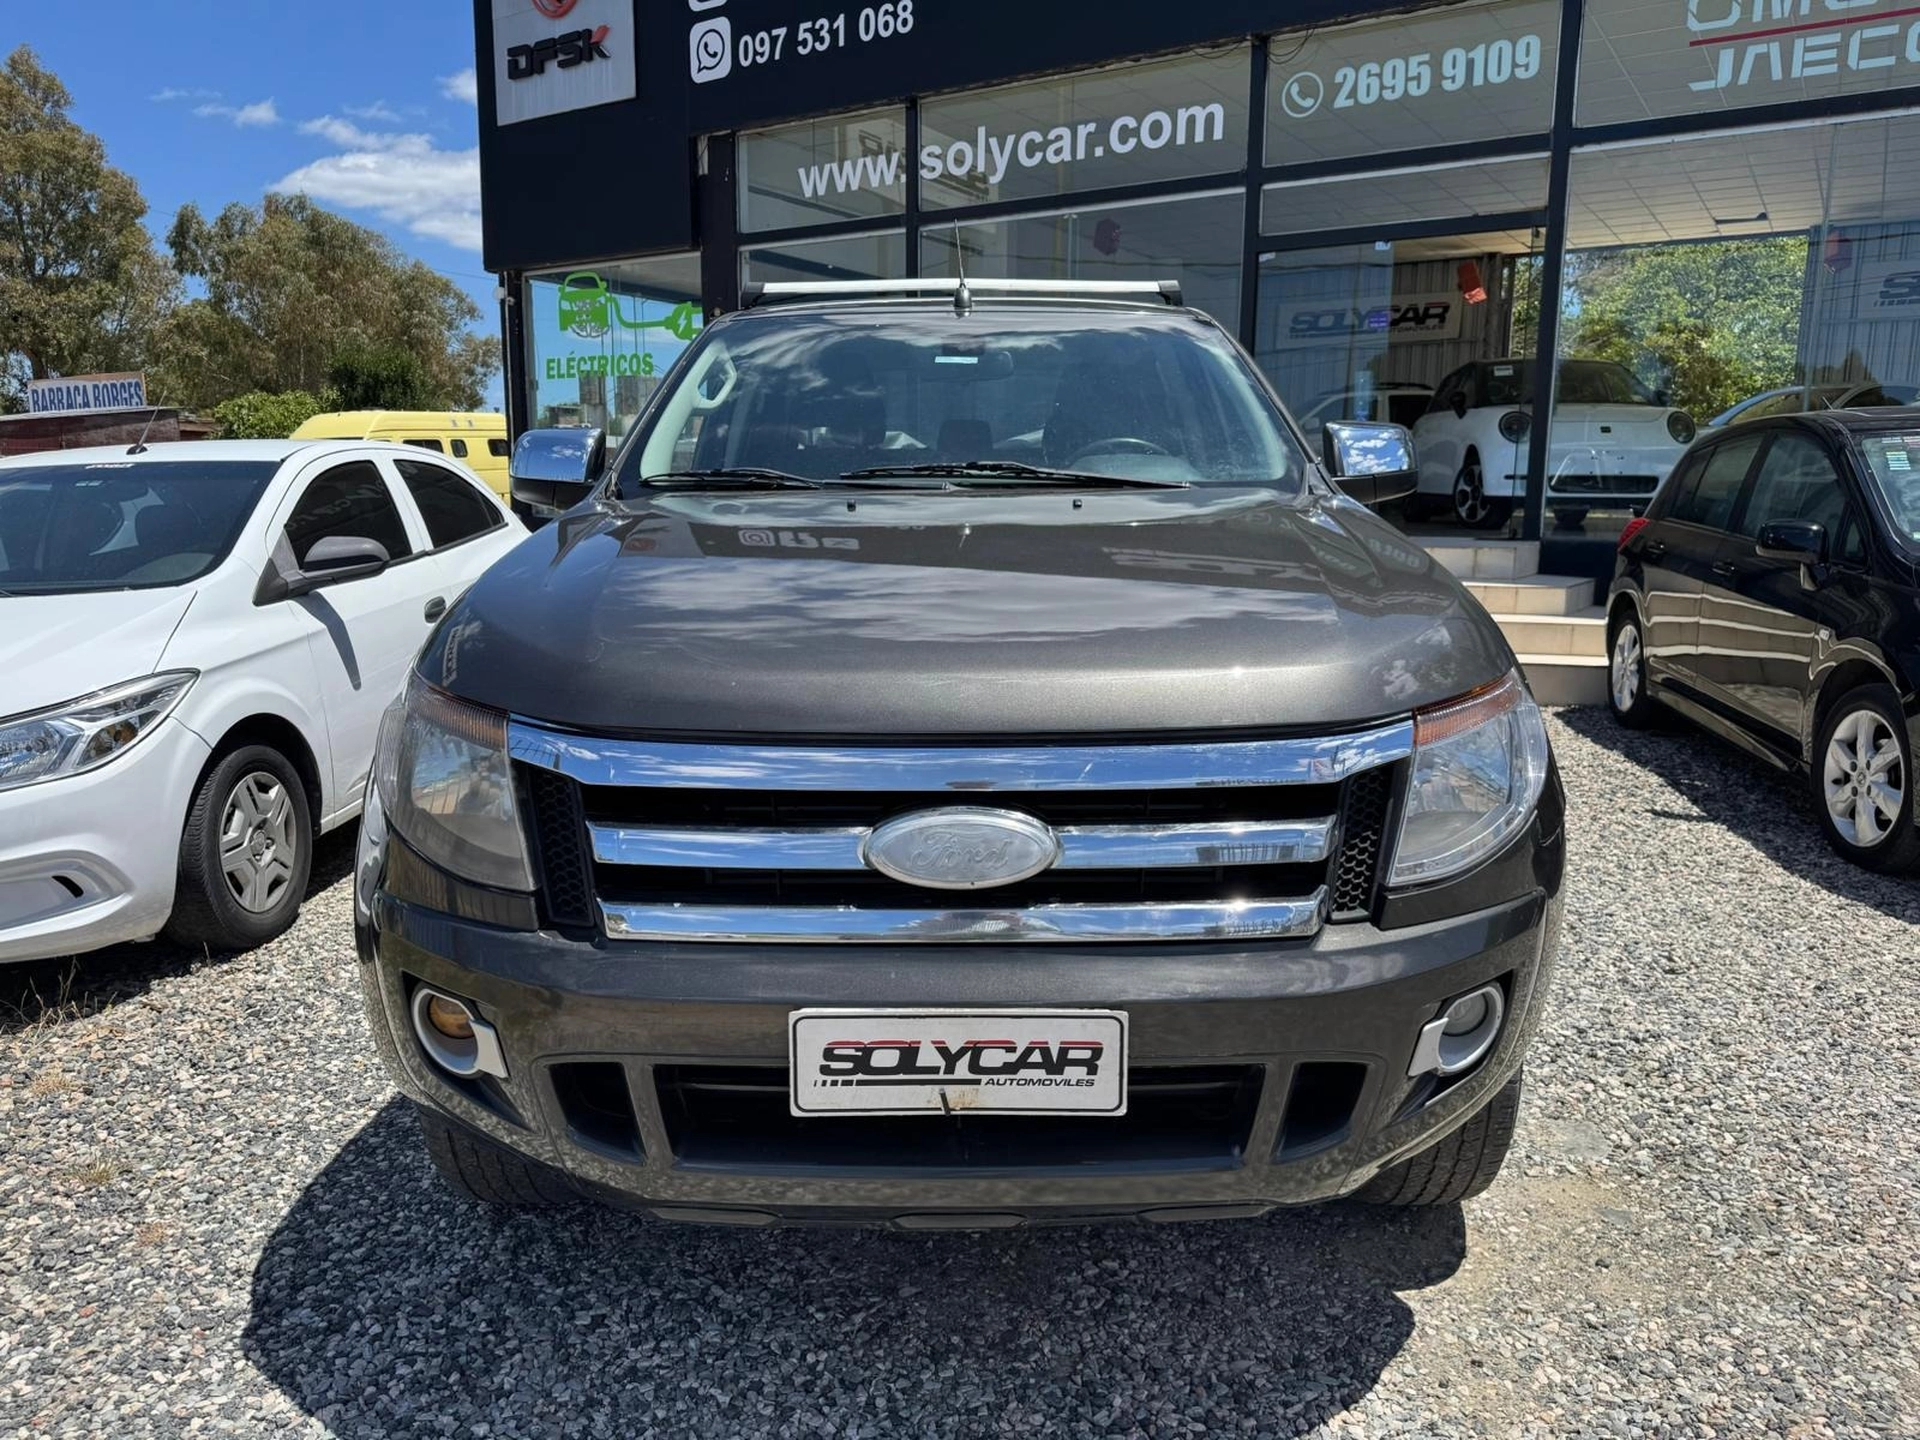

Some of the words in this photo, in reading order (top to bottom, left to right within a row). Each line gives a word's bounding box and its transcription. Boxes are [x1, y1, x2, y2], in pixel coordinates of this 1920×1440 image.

[507, 25, 611, 80] DFSK
[738, 26, 788, 68] 097
[797, 13, 845, 56] 531
[858, 0, 914, 42] 068
[1333, 52, 1432, 110] 2695
[1440, 34, 1542, 92] 9109
[1688, 20, 1920, 92] JAEC
[546, 351, 655, 380] ELÉCTRICOS
[31, 384, 91, 413] BARRACA
[92, 381, 143, 408] BORGES
[911, 828, 1015, 870] Ford
[819, 1040, 1104, 1077] SOLYCAR
[984, 1077, 1095, 1087] AUTOMOVILES
